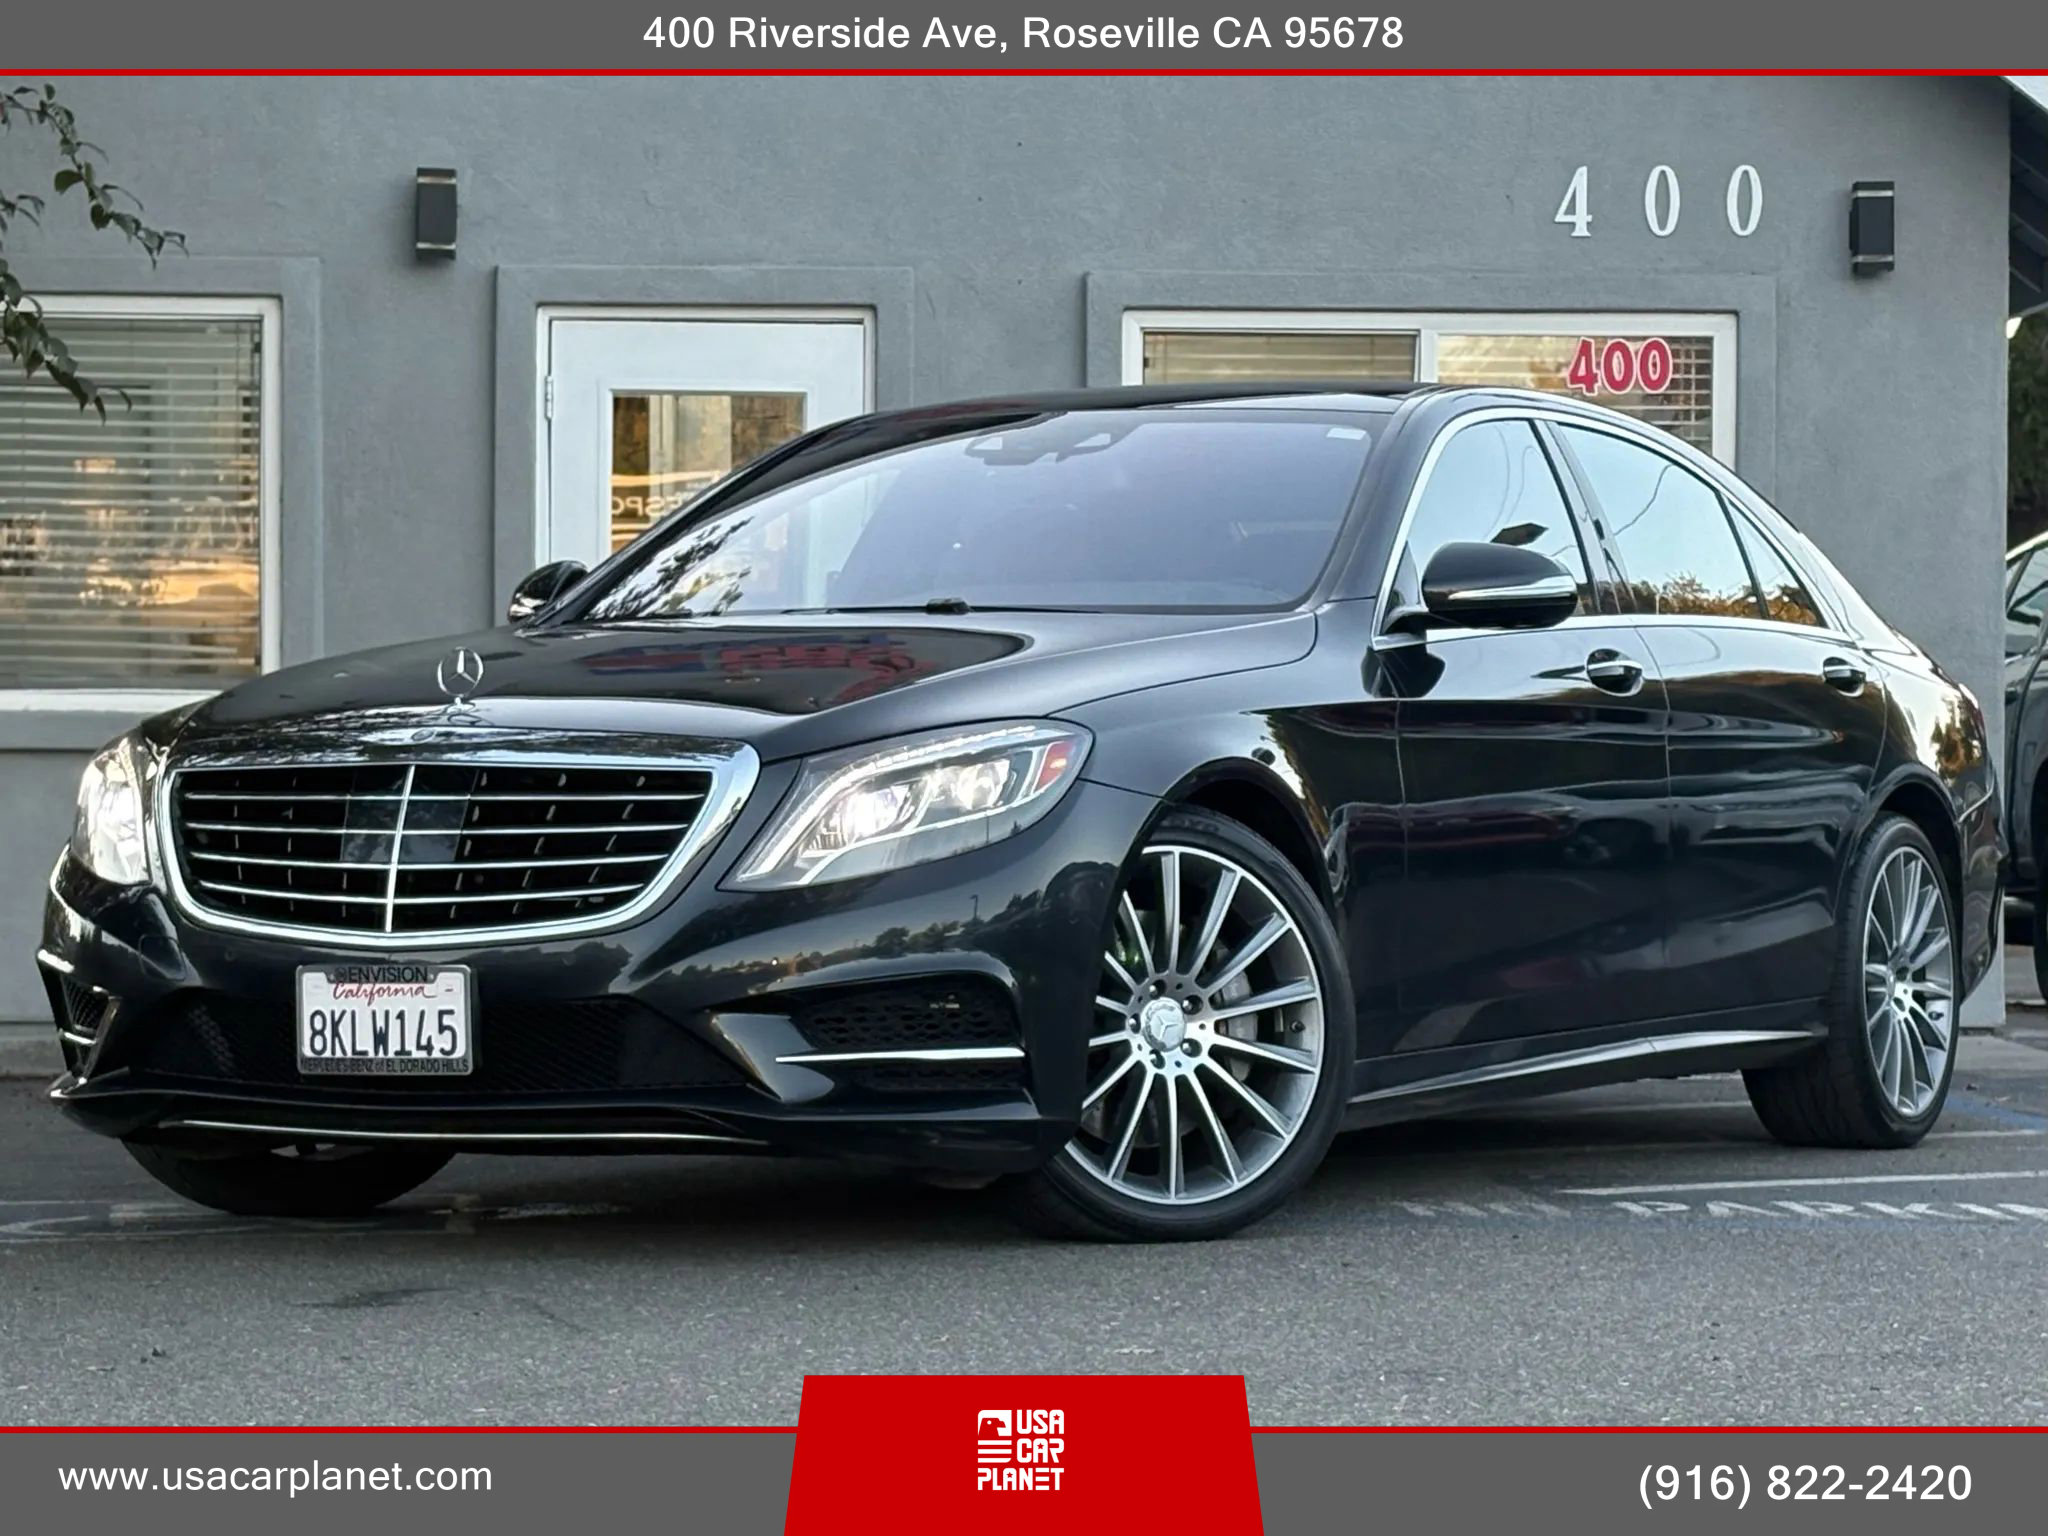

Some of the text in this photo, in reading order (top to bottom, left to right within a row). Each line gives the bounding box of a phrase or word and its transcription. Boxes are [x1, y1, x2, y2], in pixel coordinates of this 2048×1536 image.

[1554, 165, 1763, 237] 400
[1567, 336, 1672, 396] 400
[349, 966, 428, 983] ENVISION
[333, 981, 438, 1006] California
[309, 1009, 458, 1056] 8KLW145
[400, 1059, 440, 1072] DORADO
[442, 1059, 469, 1072] HILLS
